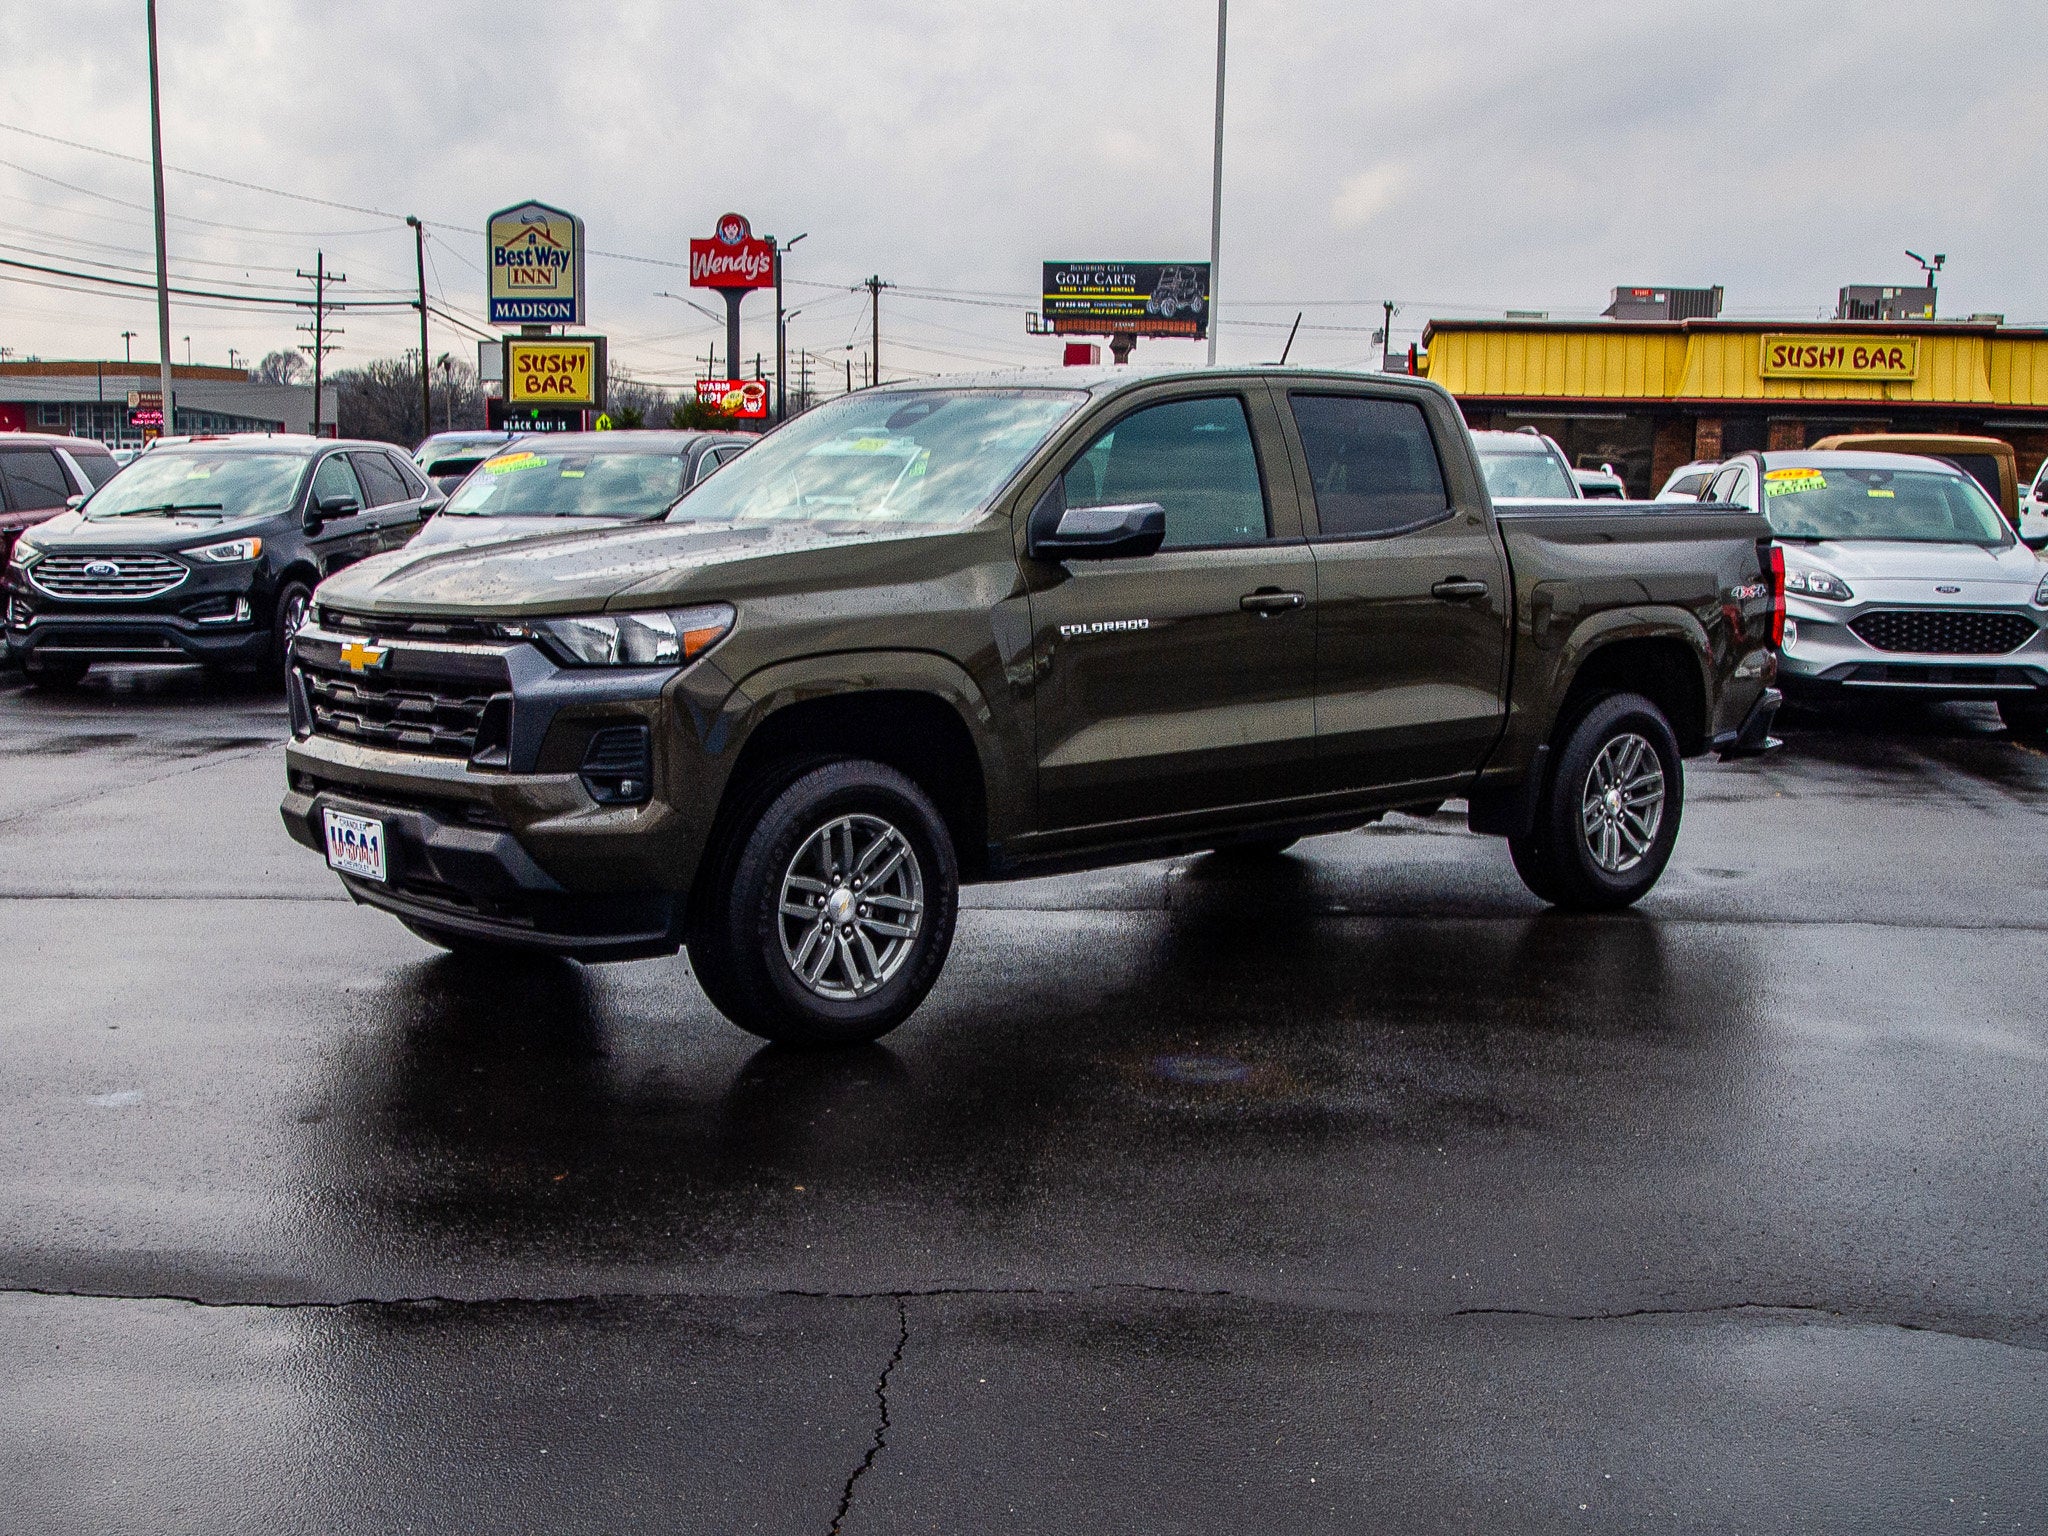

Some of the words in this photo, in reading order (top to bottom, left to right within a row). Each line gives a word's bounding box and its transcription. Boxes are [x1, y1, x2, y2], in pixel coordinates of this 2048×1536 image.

[495, 246, 533, 267] Best
[534, 246, 570, 273] Way
[692, 245, 770, 280] Wendy's
[513, 268, 552, 285] INN
[1055, 271, 1090, 285] GOLF
[1094, 271, 1136, 285] CARTS
[495, 302, 571, 318] MADISON
[518, 353, 585, 373] SUSHI
[1772, 345, 1845, 369] SUSHI
[1853, 346, 1907, 370] BAR
[525, 374, 577, 394] BAR
[699, 382, 731, 391] WARM
[503, 420, 532, 431] BLACK
[1060, 618, 1149, 637] COLORADO
